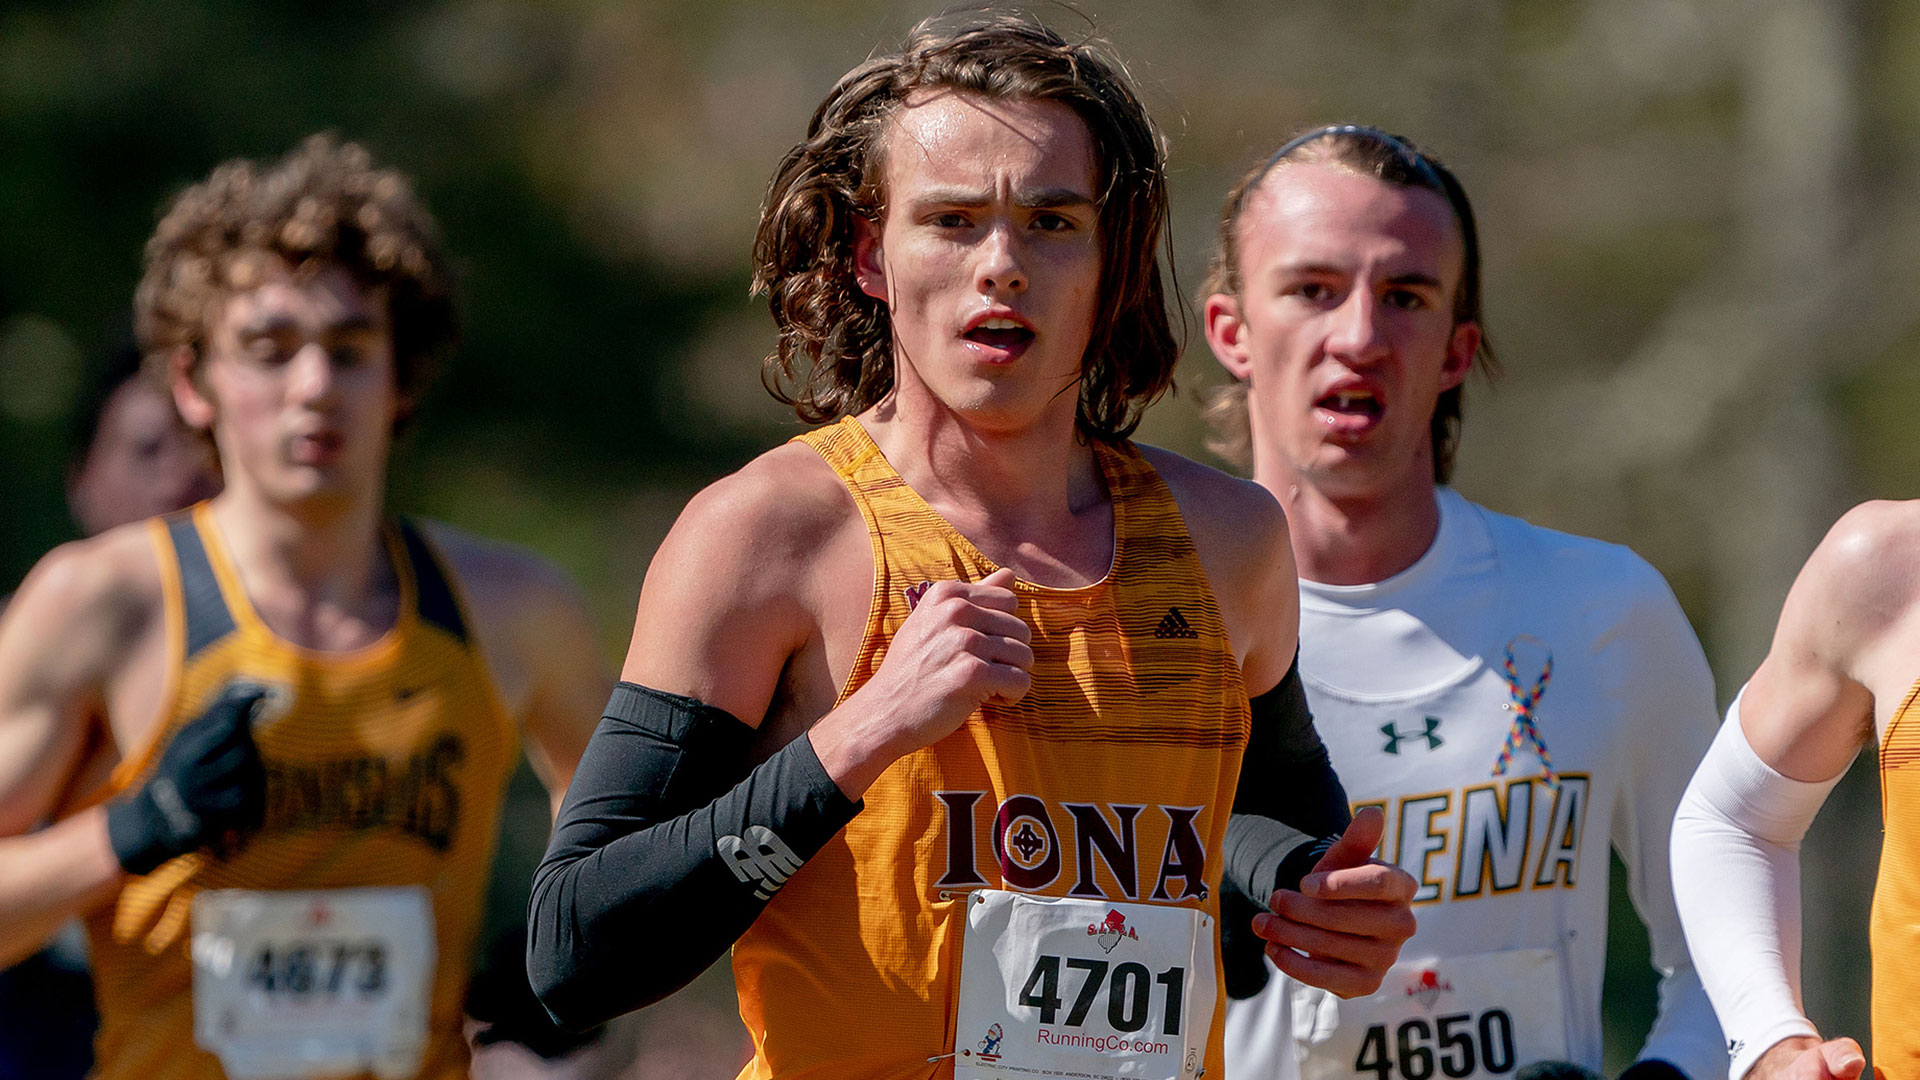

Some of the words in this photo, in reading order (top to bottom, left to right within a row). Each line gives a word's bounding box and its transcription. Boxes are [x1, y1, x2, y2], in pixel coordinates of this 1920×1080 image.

[932, 790, 1211, 901] IONA
[248, 938, 390, 995] 4673
[1018, 955, 1185, 1036] 4701
[1037, 1029, 1169, 1054] RunningCo.com
[1355, 1008, 1516, 1080] 4650
